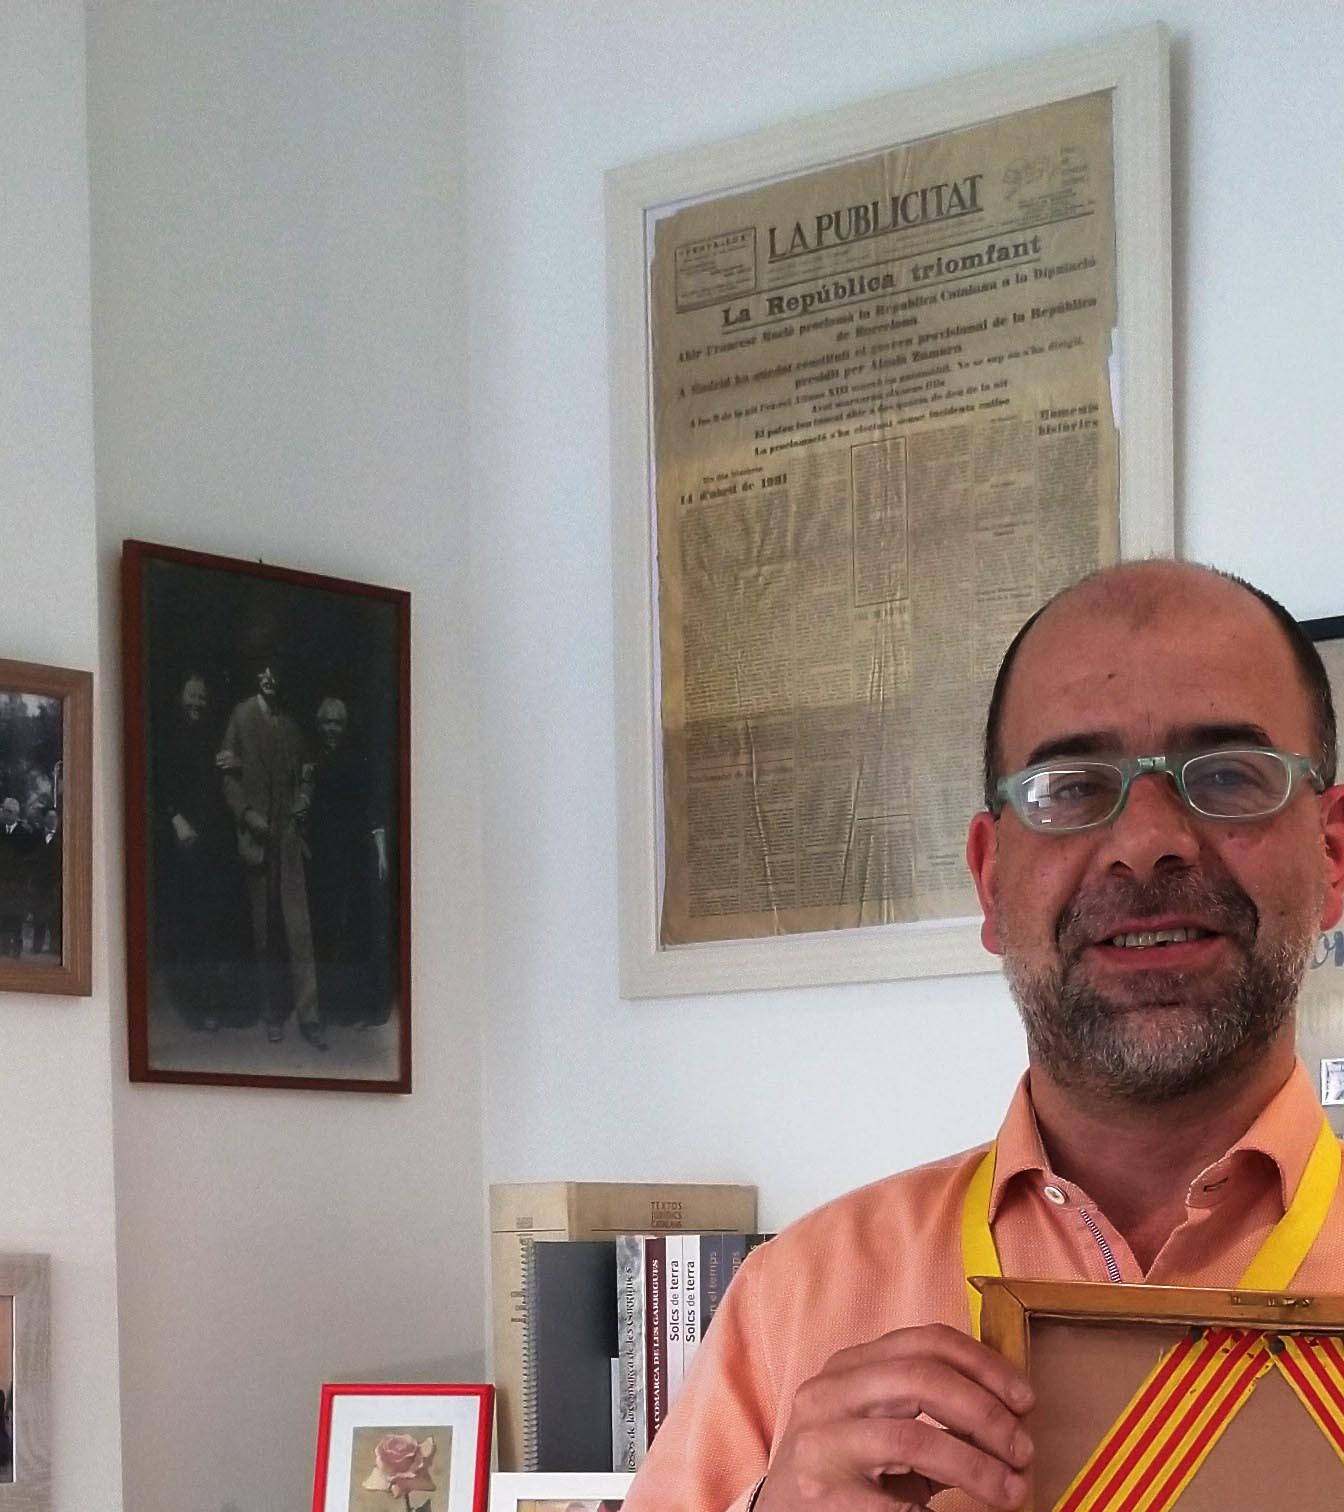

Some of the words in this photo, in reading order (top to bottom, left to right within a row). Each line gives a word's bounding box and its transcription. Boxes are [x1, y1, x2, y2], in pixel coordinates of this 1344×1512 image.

[769, 221, 811, 260] LA
[815, 173, 984, 247] PUBLICITAT
[721, 306, 752, 328] La
[766, 271, 896, 317] República
[911, 234, 1042, 282] triomfant
[670, 1260, 679, 1290] terra
[686, 1261, 695, 1291] terra
[670, 1294, 679, 1306] de
[686, 1295, 695, 1307] de
[669, 1309, 680, 1341] Solcs
[685, 1310, 696, 1342] Solcs
